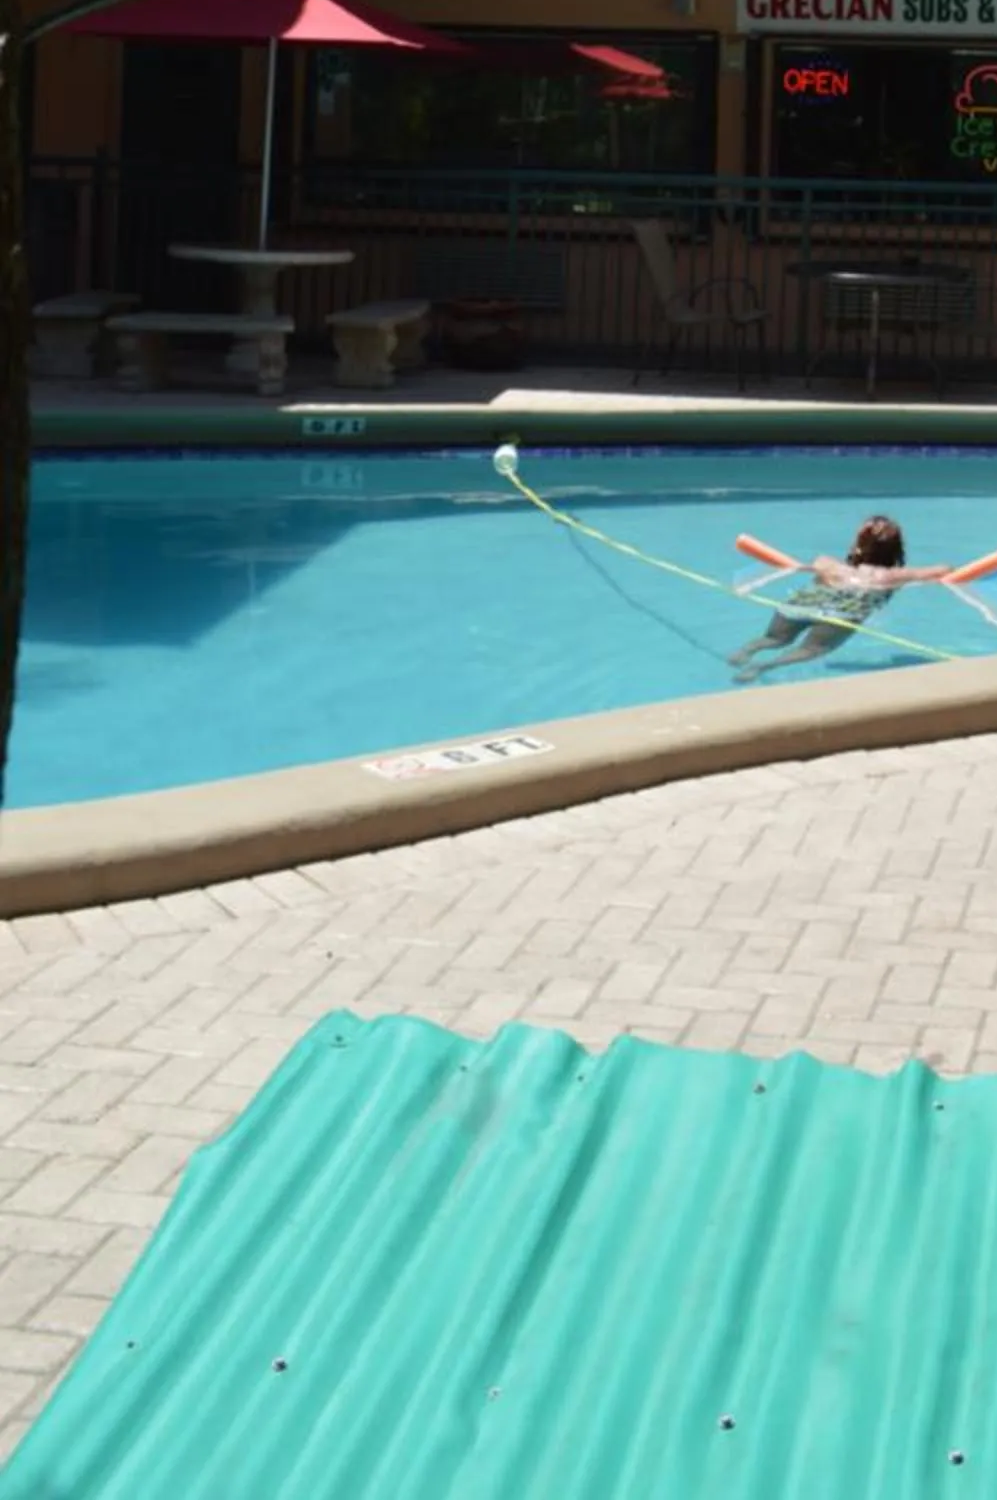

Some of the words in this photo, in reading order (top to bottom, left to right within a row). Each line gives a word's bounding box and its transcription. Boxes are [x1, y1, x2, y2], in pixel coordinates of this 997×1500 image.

[783, 68, 849, 97] OPEN
[956, 112, 995, 136] Ice
[481, 736, 541, 757] FT
